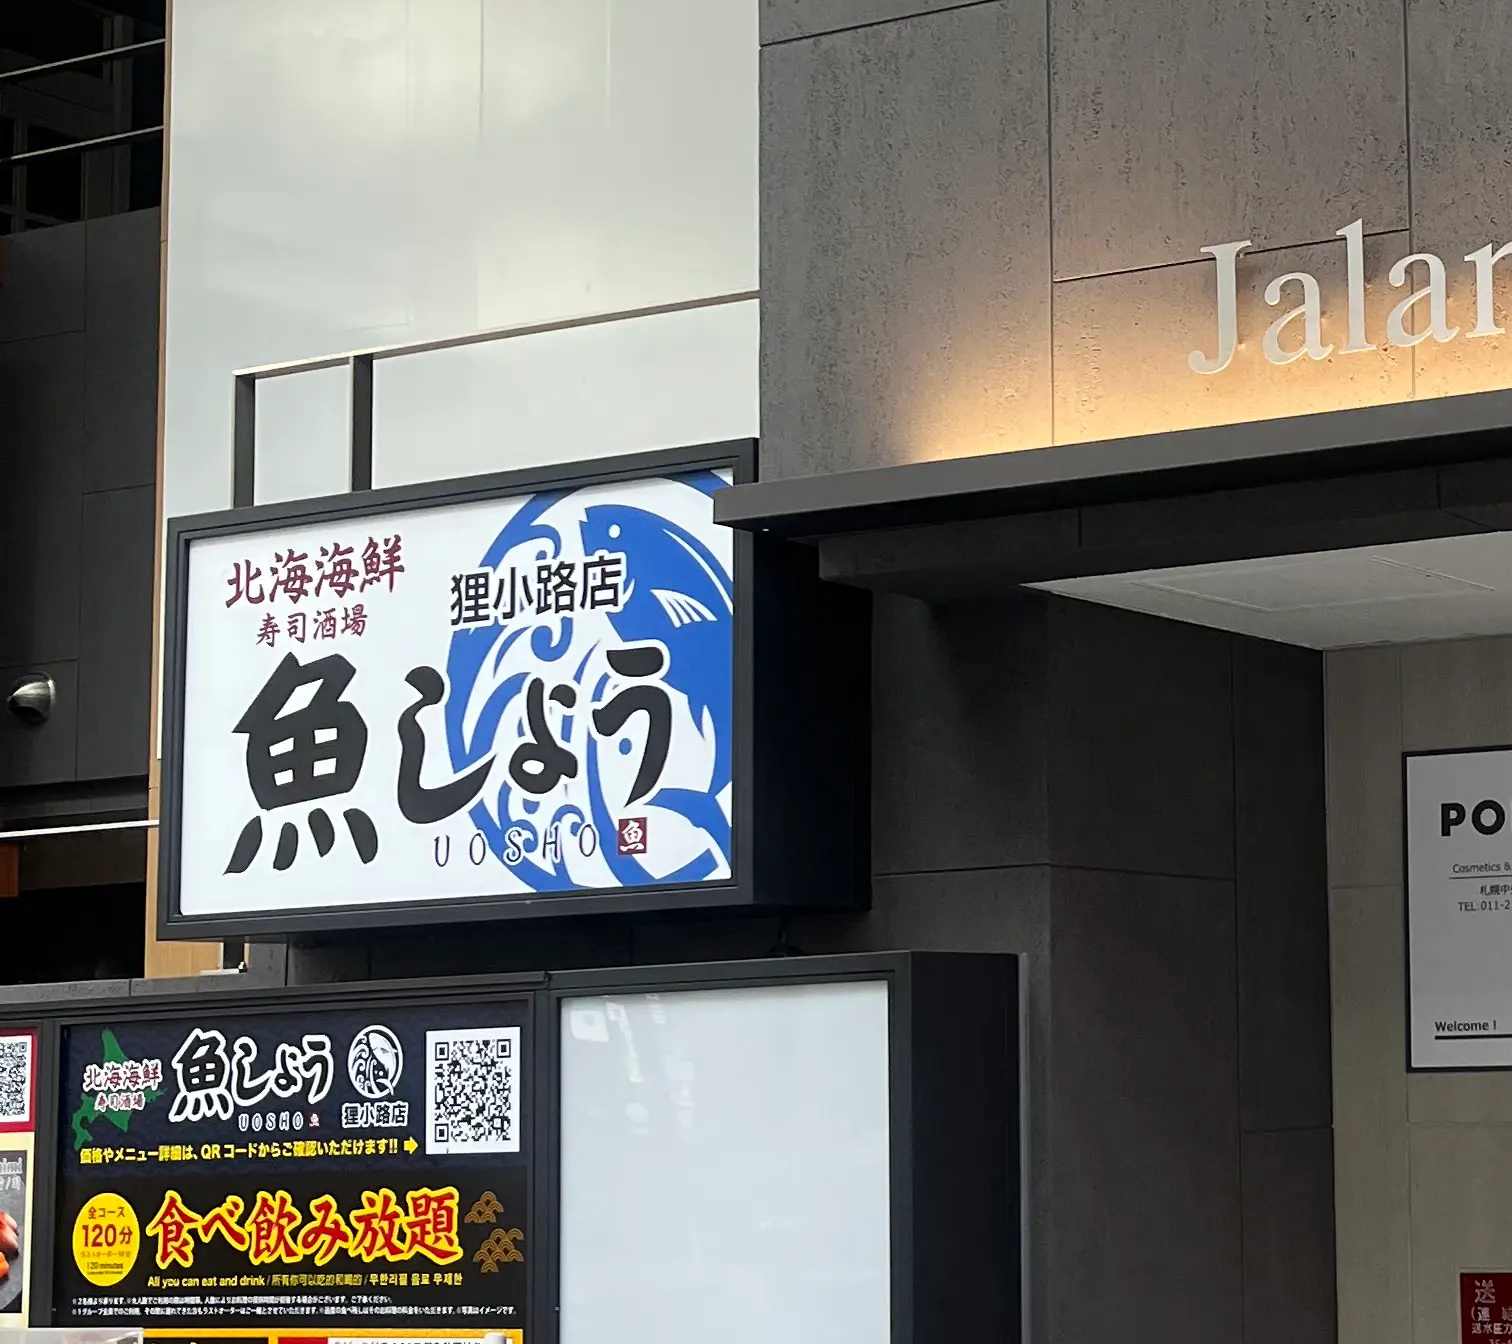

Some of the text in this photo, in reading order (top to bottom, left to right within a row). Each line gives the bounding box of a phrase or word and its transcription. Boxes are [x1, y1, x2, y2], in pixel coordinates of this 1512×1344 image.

[225, 534, 405, 609] 北海海鮮
[450, 555, 623, 626] 狸小路店
[255, 603, 368, 647] 寿司酒場
[223, 646, 673, 876] 魚しょう
[433, 823, 598, 869] UOSHO
[1452, 862, 1501, 874] Cosmetics
[1503, 861, 1512, 871] &
[1434, 1019, 1489, 1032] Welcome
[83, 1058, 163, 1091] 北海海鮮
[168, 1027, 334, 1123] 魚しょう
[94, 1092, 146, 1113] 寿司酒場
[342, 1102, 409, 1129] 狸小路店
[238, 1112, 305, 1133] UOSHO
[88, 1206, 126, 1220] 全コース
[81, 1223, 133, 1248] 120分
[148, 1188, 462, 1268] 食べ飲み放題
[148, 1274, 265, 1289] All you can eat and drink
[1471, 1322, 1512, 1335] 送水圧力
